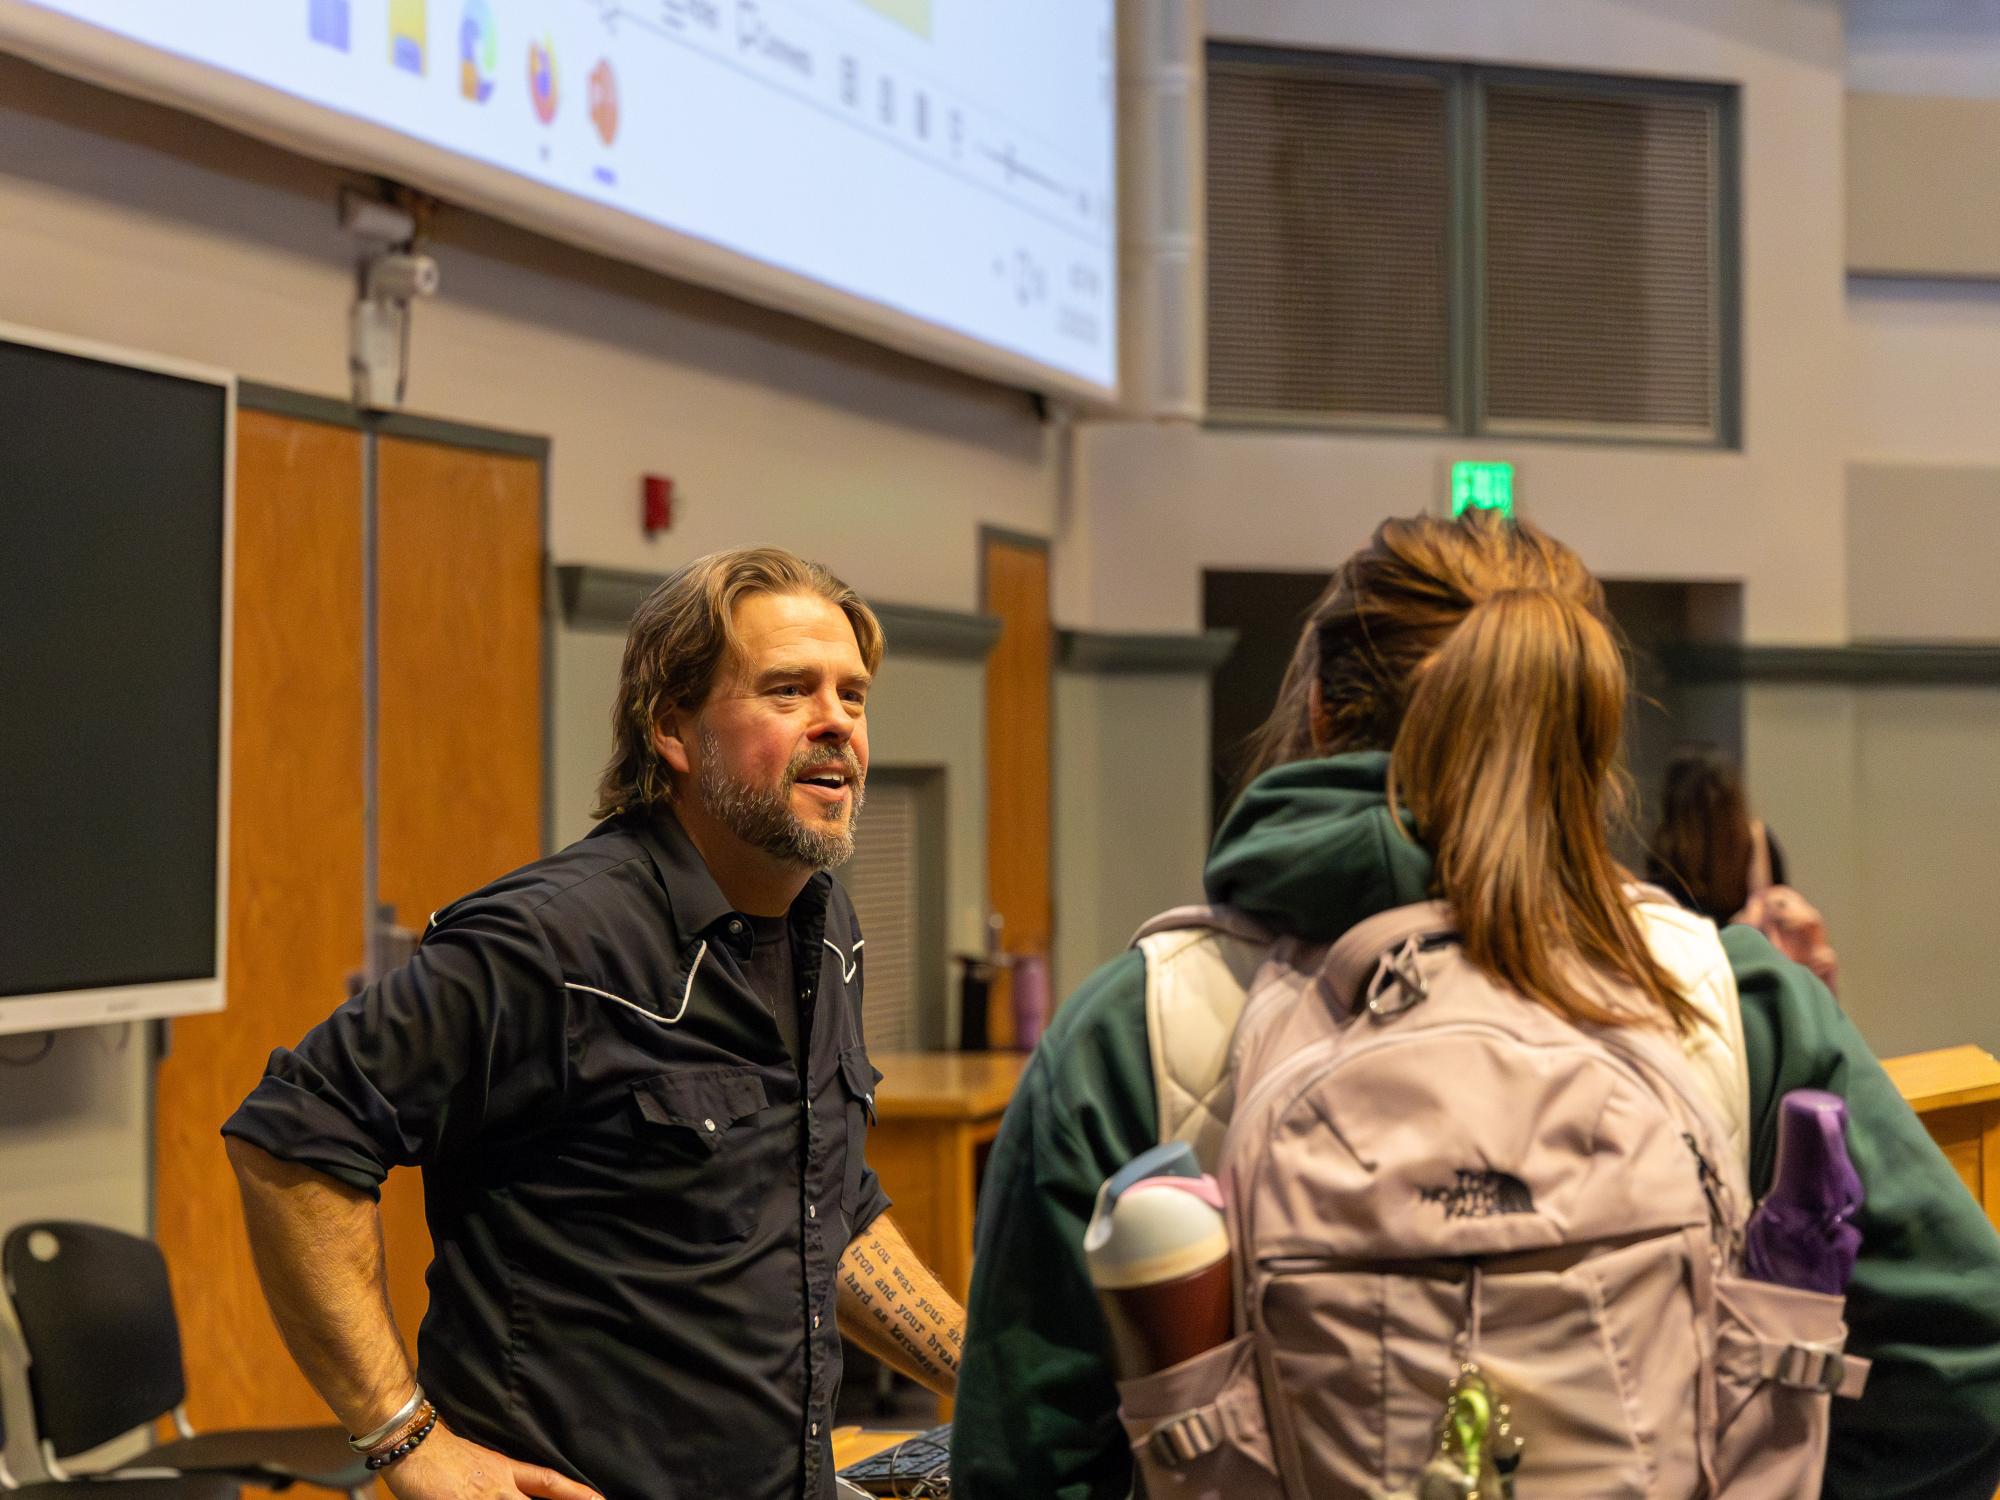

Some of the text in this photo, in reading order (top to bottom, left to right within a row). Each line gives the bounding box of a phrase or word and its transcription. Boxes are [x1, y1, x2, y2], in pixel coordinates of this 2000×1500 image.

[844, 1272, 873, 1305] hard
[873, 1307, 889, 1324] as
[850, 1246, 875, 1276] iron
[875, 1278, 897, 1302] and
[895, 1304, 925, 1333] your
[869, 1241, 891, 1265] you
[892, 1267, 916, 1295] wear
[915, 1297, 945, 1326] your
